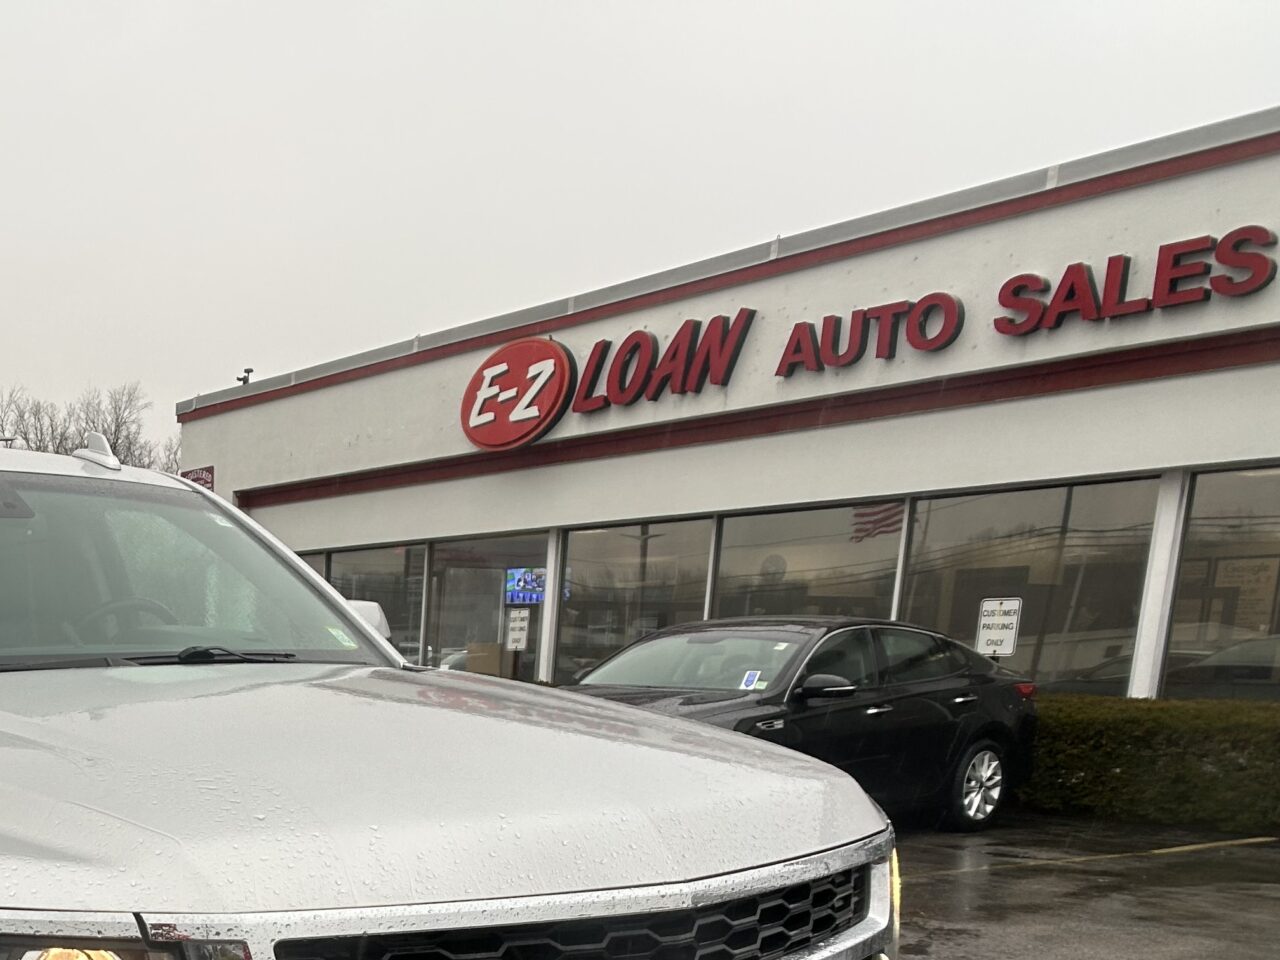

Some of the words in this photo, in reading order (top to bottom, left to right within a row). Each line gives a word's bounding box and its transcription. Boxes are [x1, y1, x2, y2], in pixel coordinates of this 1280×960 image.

[469, 358, 556, 428] E-Z
[572, 307, 757, 413] LOAN
[775, 291, 964, 377] AUTO
[992, 225, 1278, 337] SALES
[982, 609, 1018, 617] CUSTOMER
[982, 622, 1014, 630] PARKING
